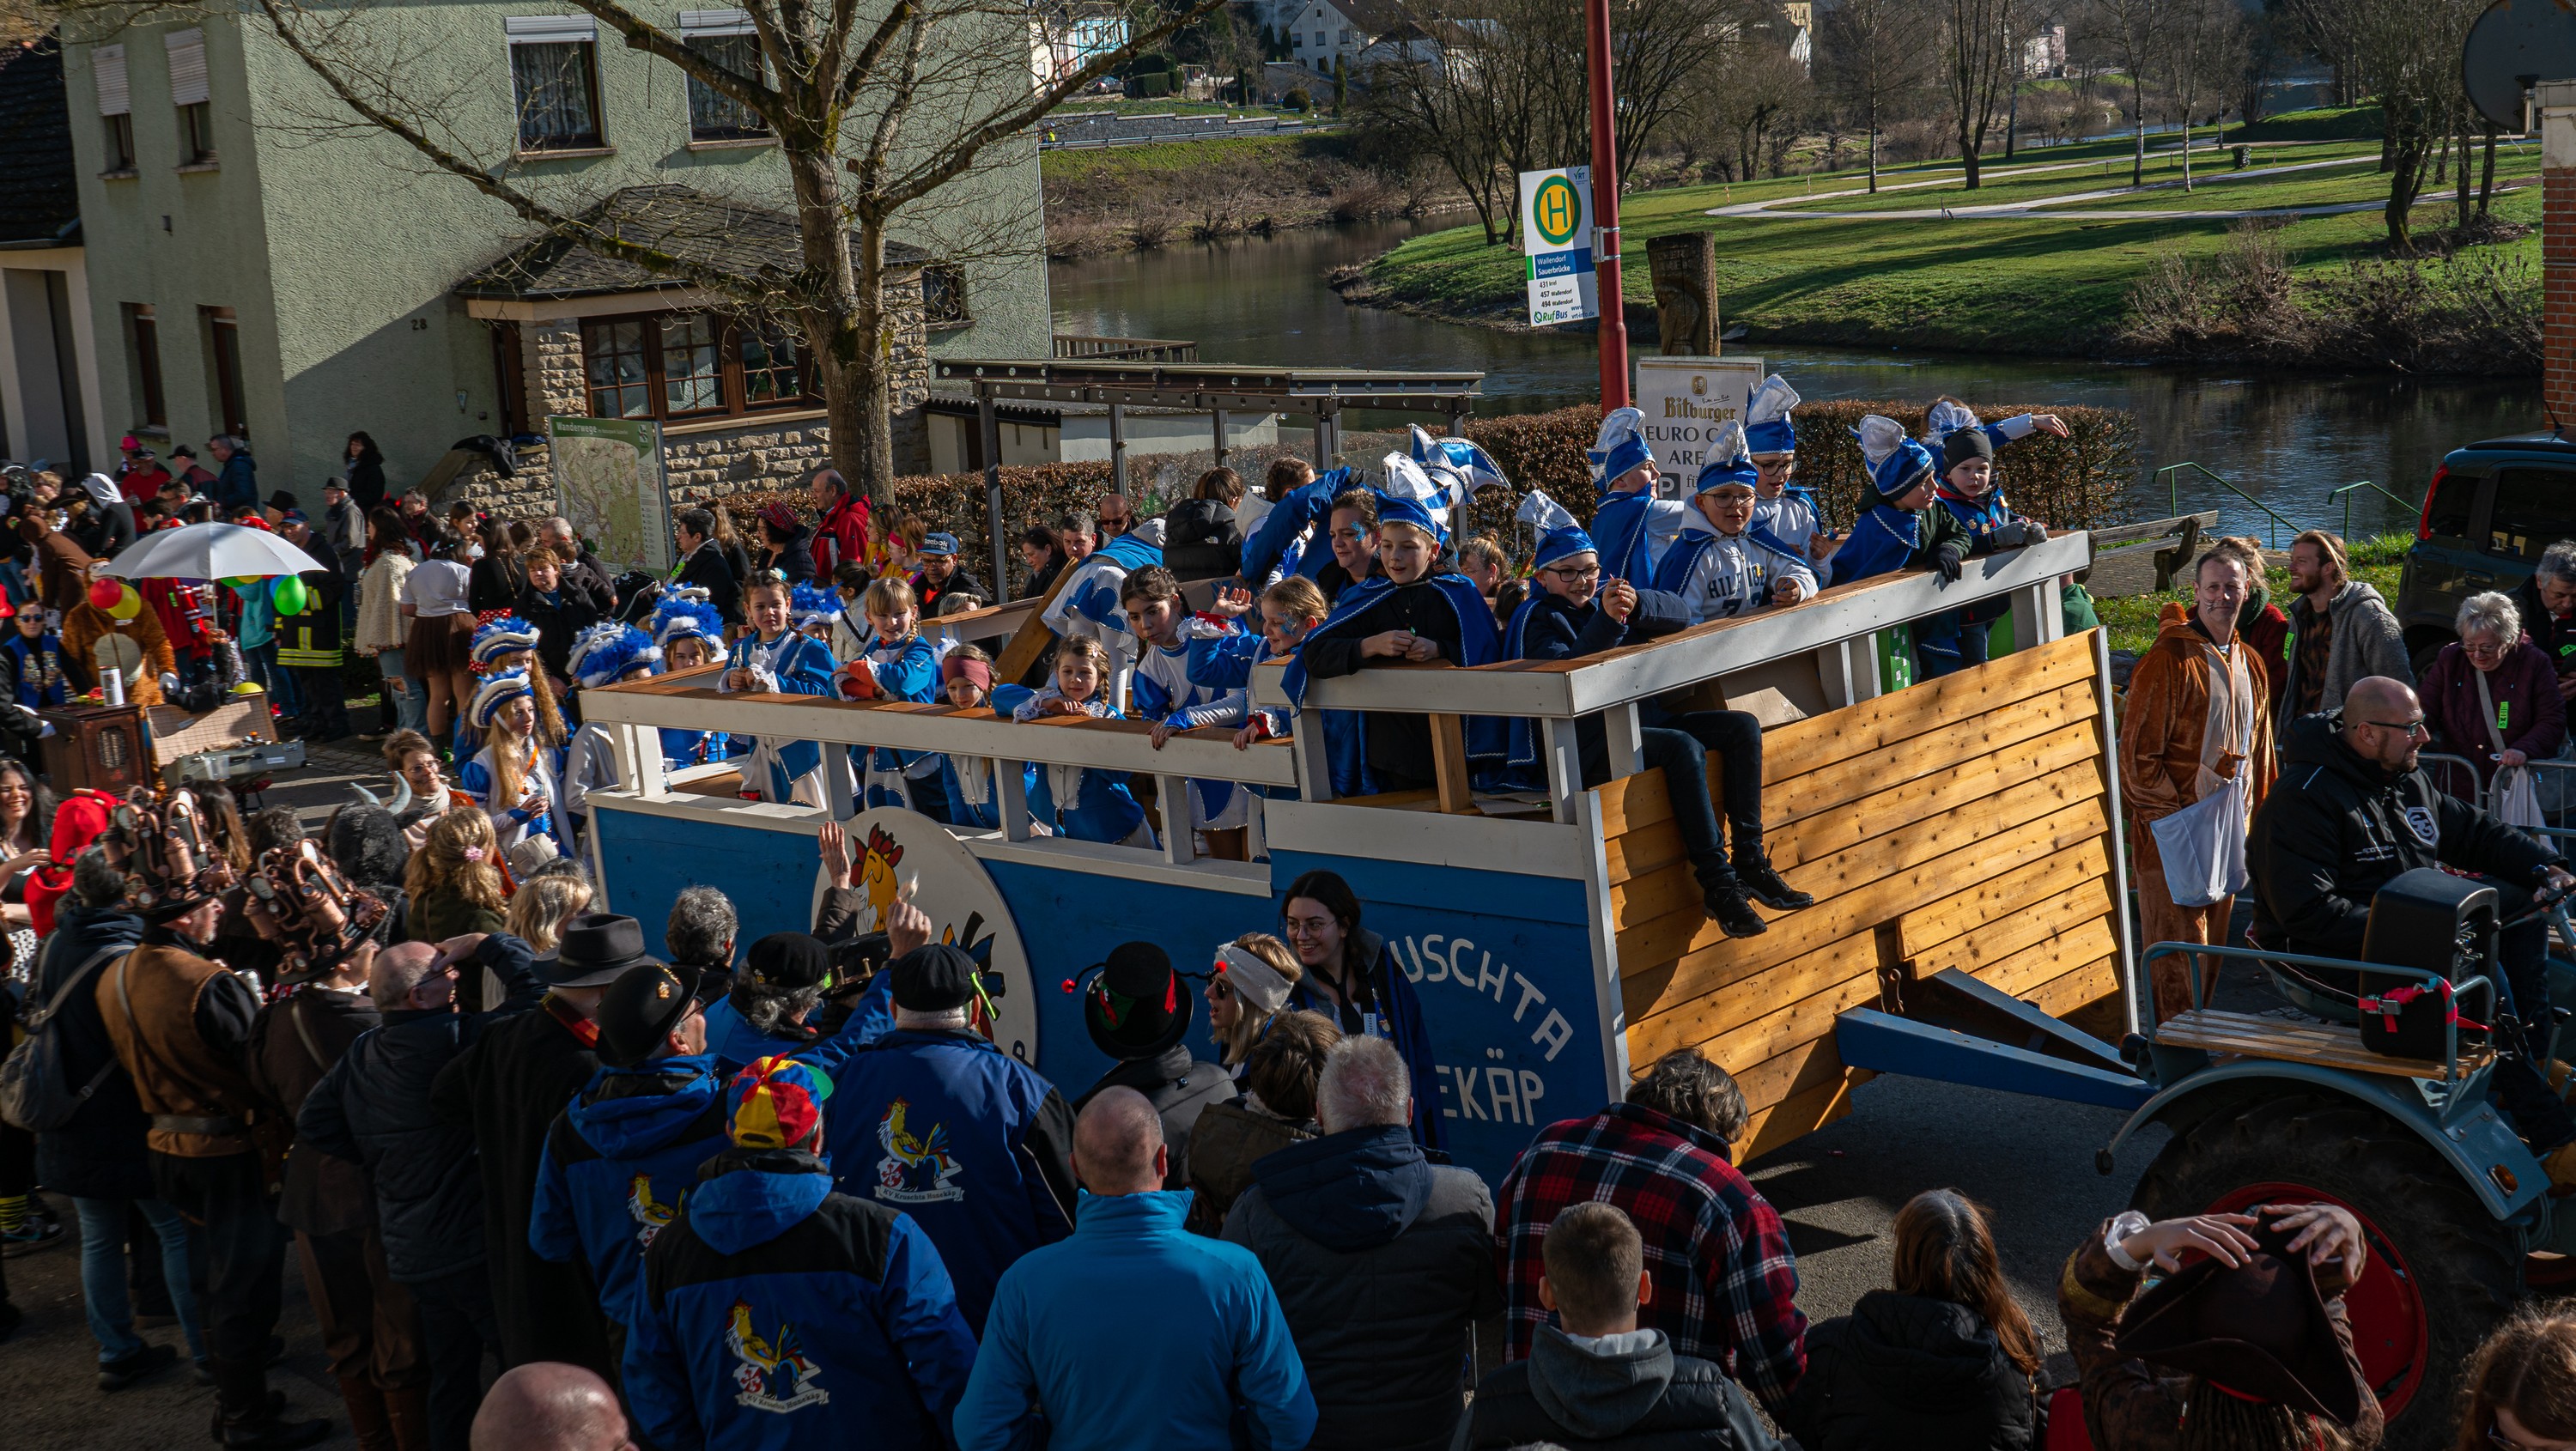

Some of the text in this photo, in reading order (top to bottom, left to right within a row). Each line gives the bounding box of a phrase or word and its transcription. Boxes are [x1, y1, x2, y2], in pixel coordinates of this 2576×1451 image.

[1574, 167, 1585, 179] VRT
[1546, 191, 1568, 230] H
[1537, 254, 1566, 265] Wallendorf
[1538, 265, 1571, 276] Sauerbrücke
[1543, 310, 1568, 323] RufBus
[410, 319, 427, 331] 28
[1663, 396, 1736, 423] Bitburger
[556, 422, 597, 434] Wanderwege
[1645, 425, 1699, 442] EURO
[1668, 450, 1706, 465] ARE
[1659, 474, 1698, 499] P fü
[1388, 933, 1574, 1063] USCHTA
[1435, 1047, 1545, 1126] EKÄP
[883, 1188, 894, 1197] KV
